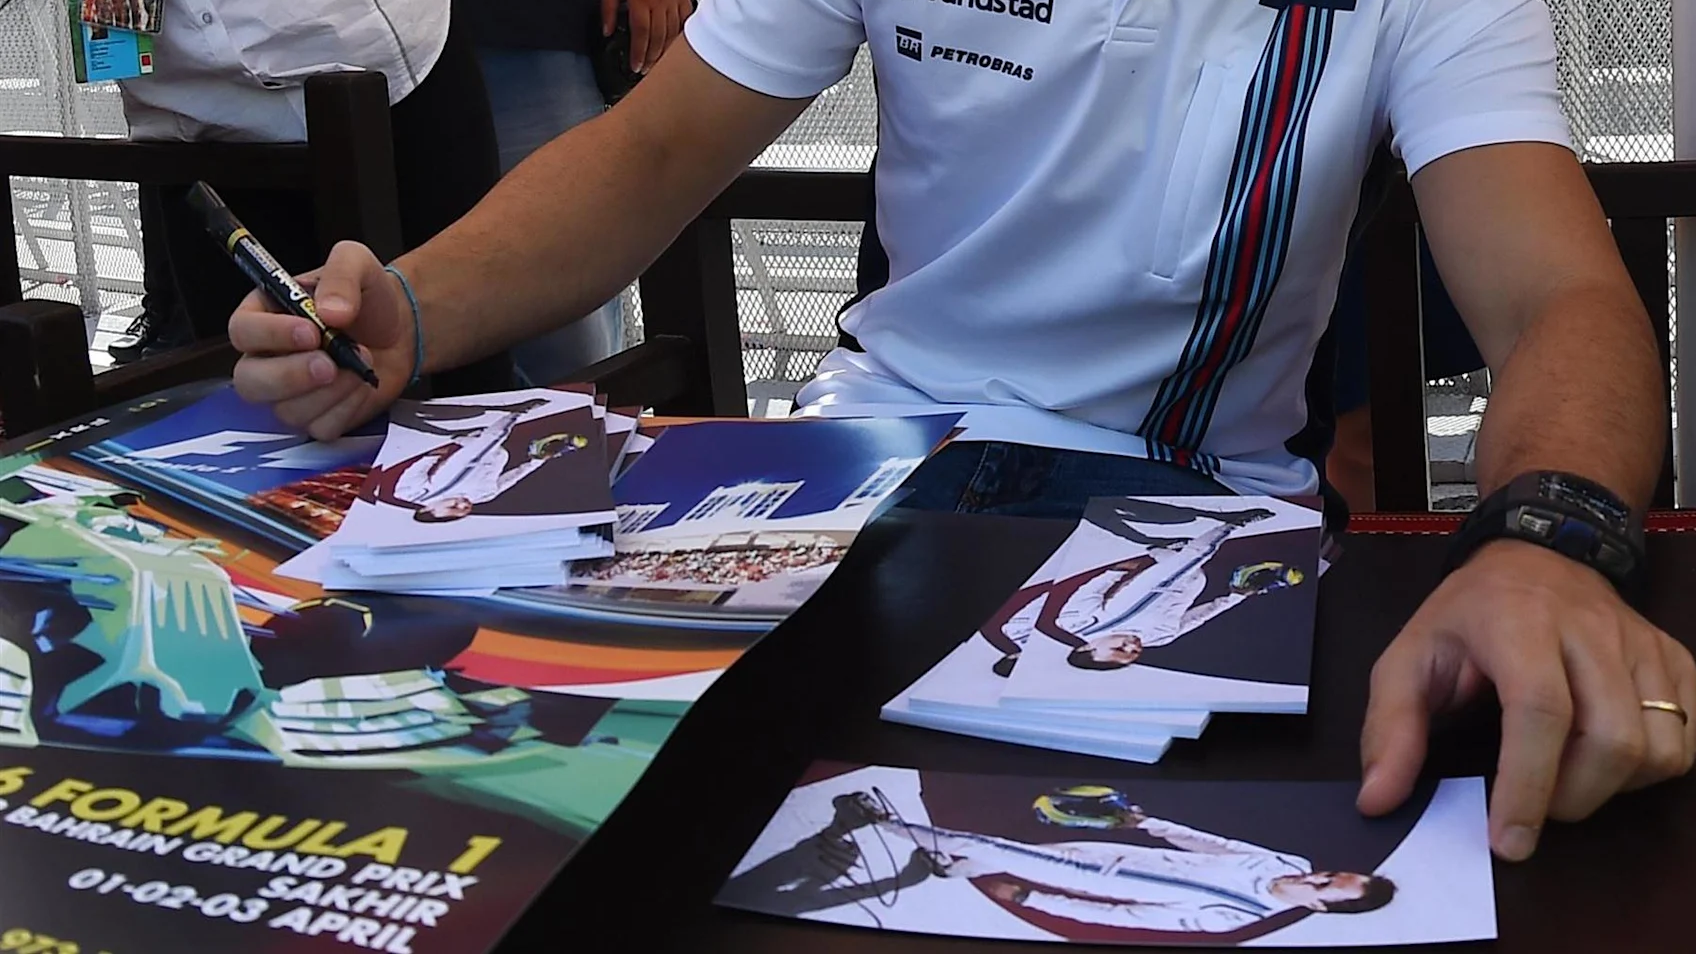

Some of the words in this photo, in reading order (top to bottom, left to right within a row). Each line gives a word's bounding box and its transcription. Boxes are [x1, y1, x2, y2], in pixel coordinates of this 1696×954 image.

[930, 44, 1035, 82] PETROBRAS
[4, 804, 184, 856] BAHRAIN
[182, 842, 348, 879] GRAND
[351, 861, 479, 901] PRIX
[29, 778, 409, 865] FORMULA
[448, 835, 503, 874] 1
[68, 868, 269, 923] 01-02-03
[268, 906, 418, 954] APRIL
[257, 875, 449, 927] SAKHIR
